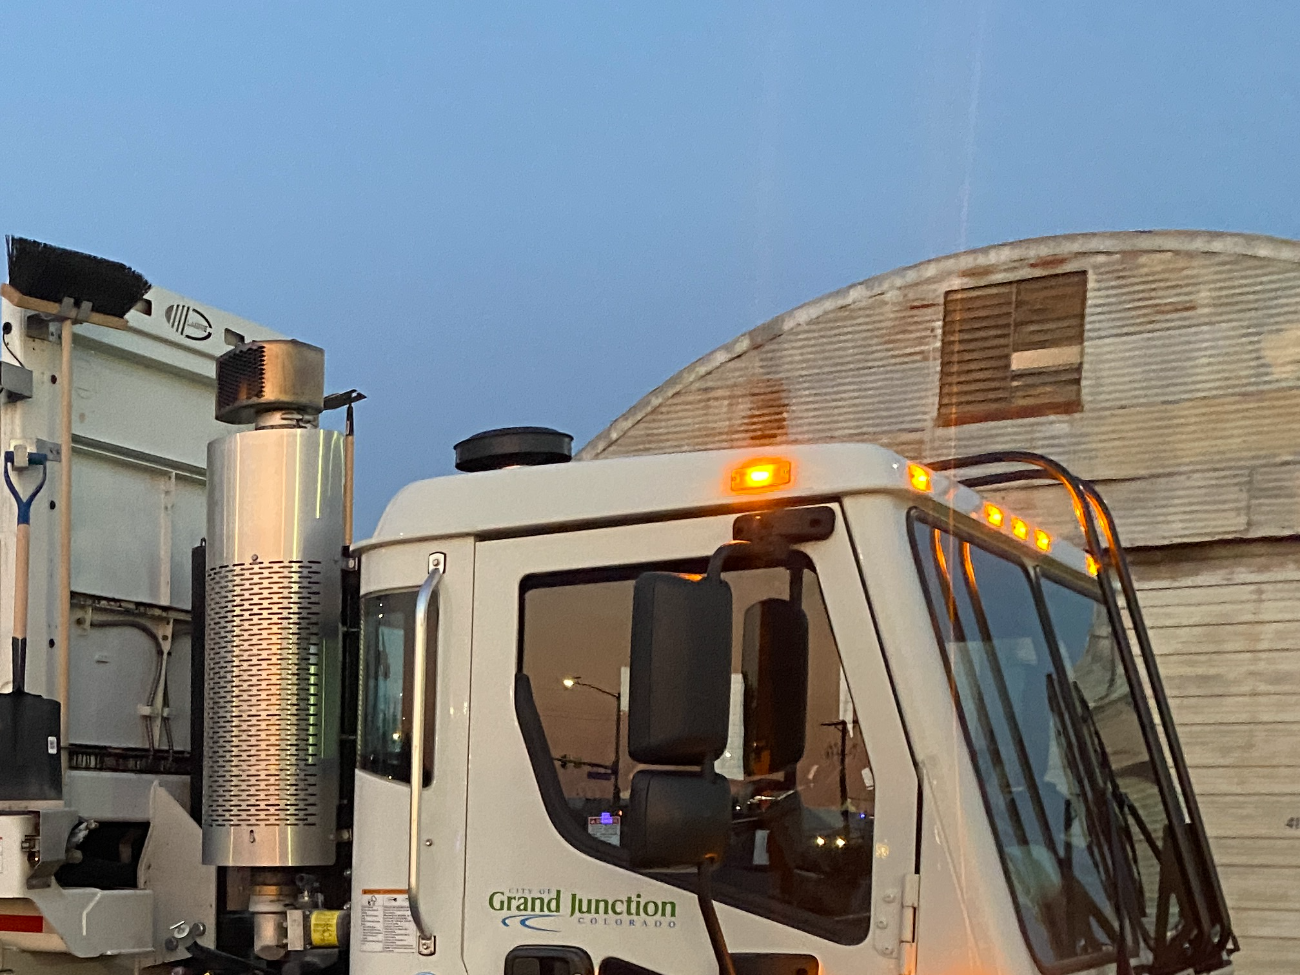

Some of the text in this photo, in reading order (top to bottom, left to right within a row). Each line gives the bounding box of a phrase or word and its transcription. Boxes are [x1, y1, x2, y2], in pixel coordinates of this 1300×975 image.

[488, 889, 677, 918] Grand Junction
[578, 917, 676, 929] COLORADO
